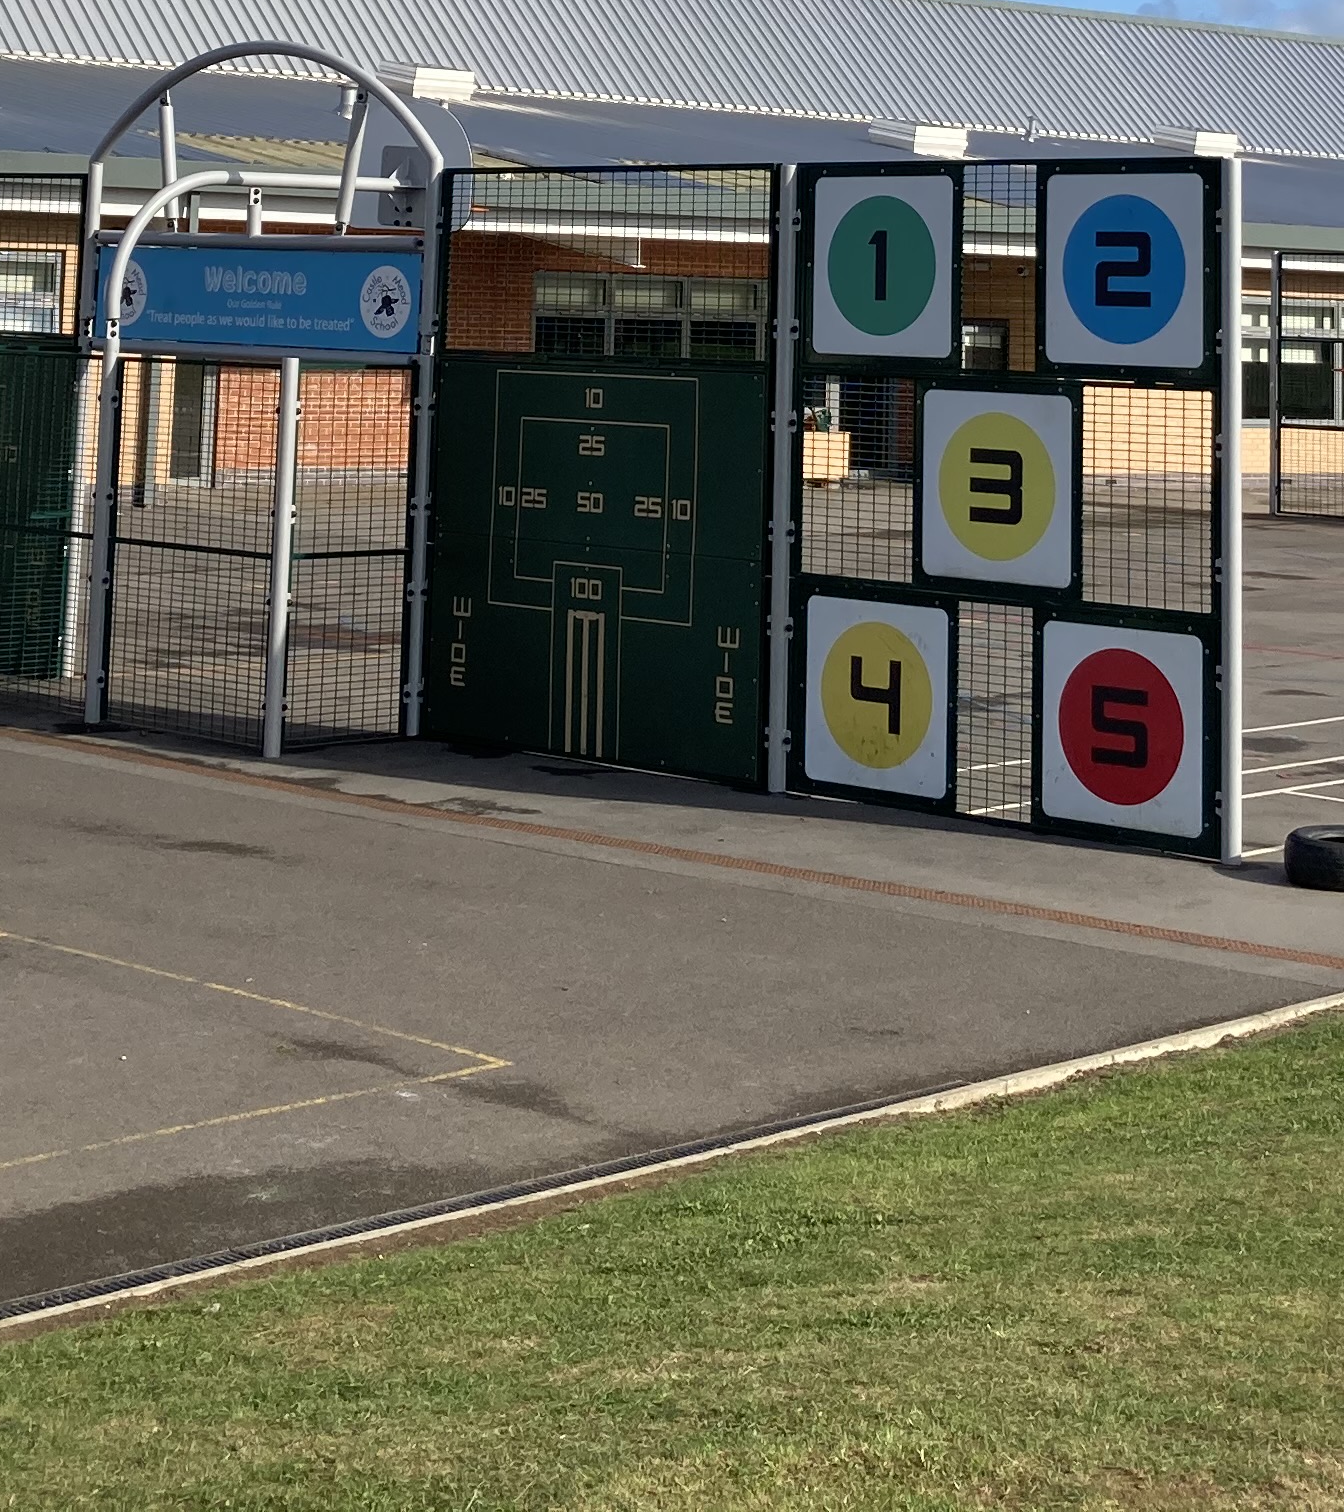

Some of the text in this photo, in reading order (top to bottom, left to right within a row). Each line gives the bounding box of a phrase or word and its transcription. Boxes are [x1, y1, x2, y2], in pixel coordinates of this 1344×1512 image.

[205, 265, 308, 296] Welcome
[867, 229, 888, 301] 1
[1093, 230, 1152, 308] 2
[392, 275, 410, 305] Mead
[174, 311, 205, 328] people
[207, 315, 217, 326] as
[219, 316, 233, 327] we
[235, 313, 266, 328] would
[267, 314, 285, 328] like
[286, 316, 297, 329] to
[299, 315, 312, 330] be
[370, 316, 399, 332] School
[584, 388, 603, 409] 10
[578, 434, 606, 457] 25
[498, 485, 691, 521] 10 25 50 25 10
[968, 447, 1023, 526] 3
[570, 577, 603, 601] 100
[450, 595, 472, 687] WIDE
[714, 625, 740, 725] WIDE
[850, 654, 903, 736] 4
[1090, 684, 1149, 769] 5
